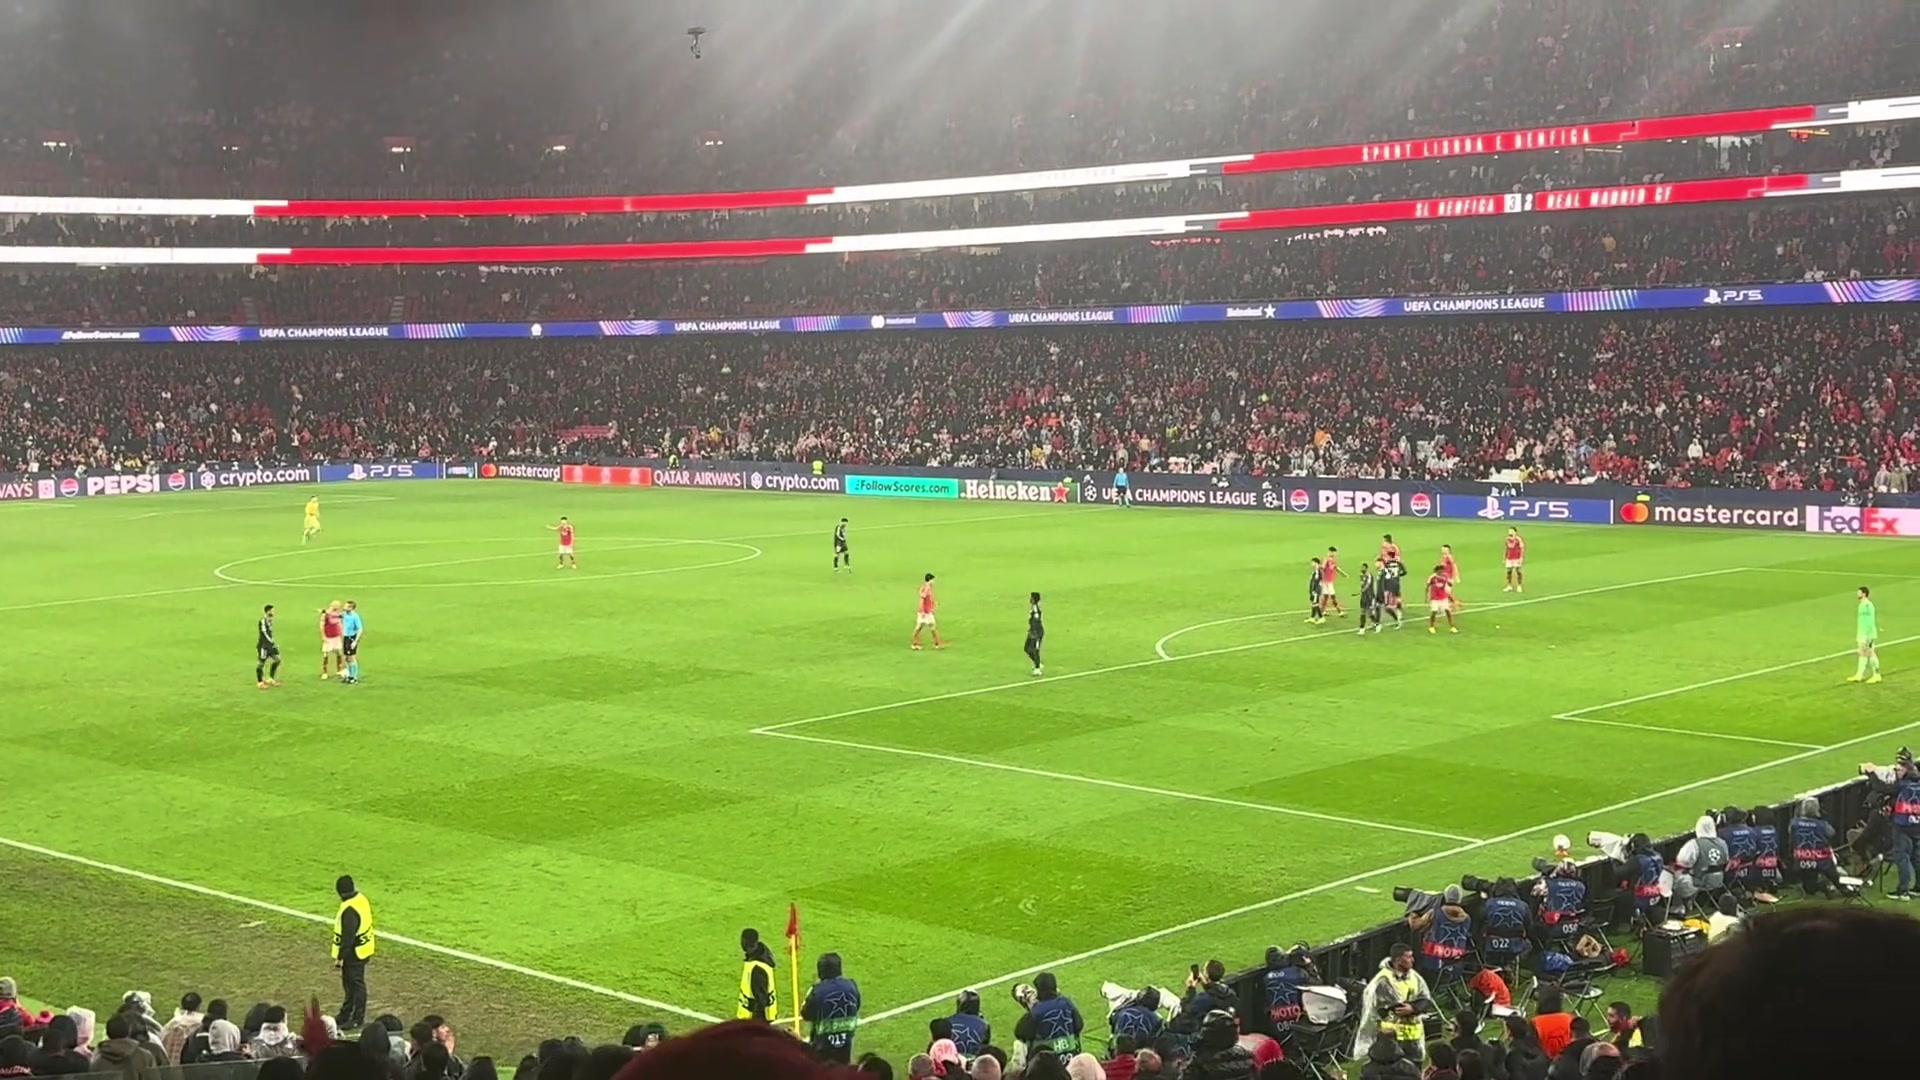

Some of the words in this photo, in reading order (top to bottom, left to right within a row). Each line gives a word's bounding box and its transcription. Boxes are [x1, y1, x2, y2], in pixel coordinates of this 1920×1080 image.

[1362, 144, 1412, 162] SPORT
[1423, 137, 1484, 157] LISBOA
[1496, 135, 1503, 150] E
[1515, 128, 1590, 149] BENFICA
[1415, 202, 1430, 217] SL
[1437, 198, 1495, 215] BENFICA
[1523, 194, 1533, 211] 2
[1546, 191, 1581, 209] REAL
[1589, 187, 1647, 206] MADRID
[1654, 186, 1673, 203] CF
[1723, 289, 1763, 301] PS5
[1404, 300, 1432, 312] UEFA
[1433, 298, 1499, 311] CHAMPIONS
[1501, 297, 1545, 309] LEAGUE
[675, 322, 698, 332] UEFA
[699, 321, 748, 332] CHAMPIONS
[749, 320, 781, 330] LEAGUE
[1009, 313, 1029, 324] UEFA
[1030, 312, 1080, 323] CHAMPIONS
[1081, 311, 1114, 321] LEAGUE
[259, 327, 286, 338] UEFA
[287, 326, 348, 338] CHAMPIONS
[349, 326, 389, 337] LEAGUE
[219, 465, 310, 487] crypto.com
[370, 464, 414, 478] PS5
[499, 464, 561, 479] mastercard
[654, 470, 690, 486] QATAR
[694, 471, 741, 487] AIRWAYS
[87, 474, 161, 496] PEPSI
[765, 474, 840, 491] crypto.com
[860, 479, 950, 494] FollowScores.com
[964, 479, 1051, 501] Heineken
[1101, 487, 1133, 501] UEA
[1135, 488, 1206, 504] CHAMPIONS
[1209, 490, 1258, 506] LEAGUE
[1318, 489, 1401, 516] PEPSI
[1508, 500, 1571, 519] PS5
[1654, 503, 1799, 527] mastercard
[1818, 507, 1900, 535] FedEx
